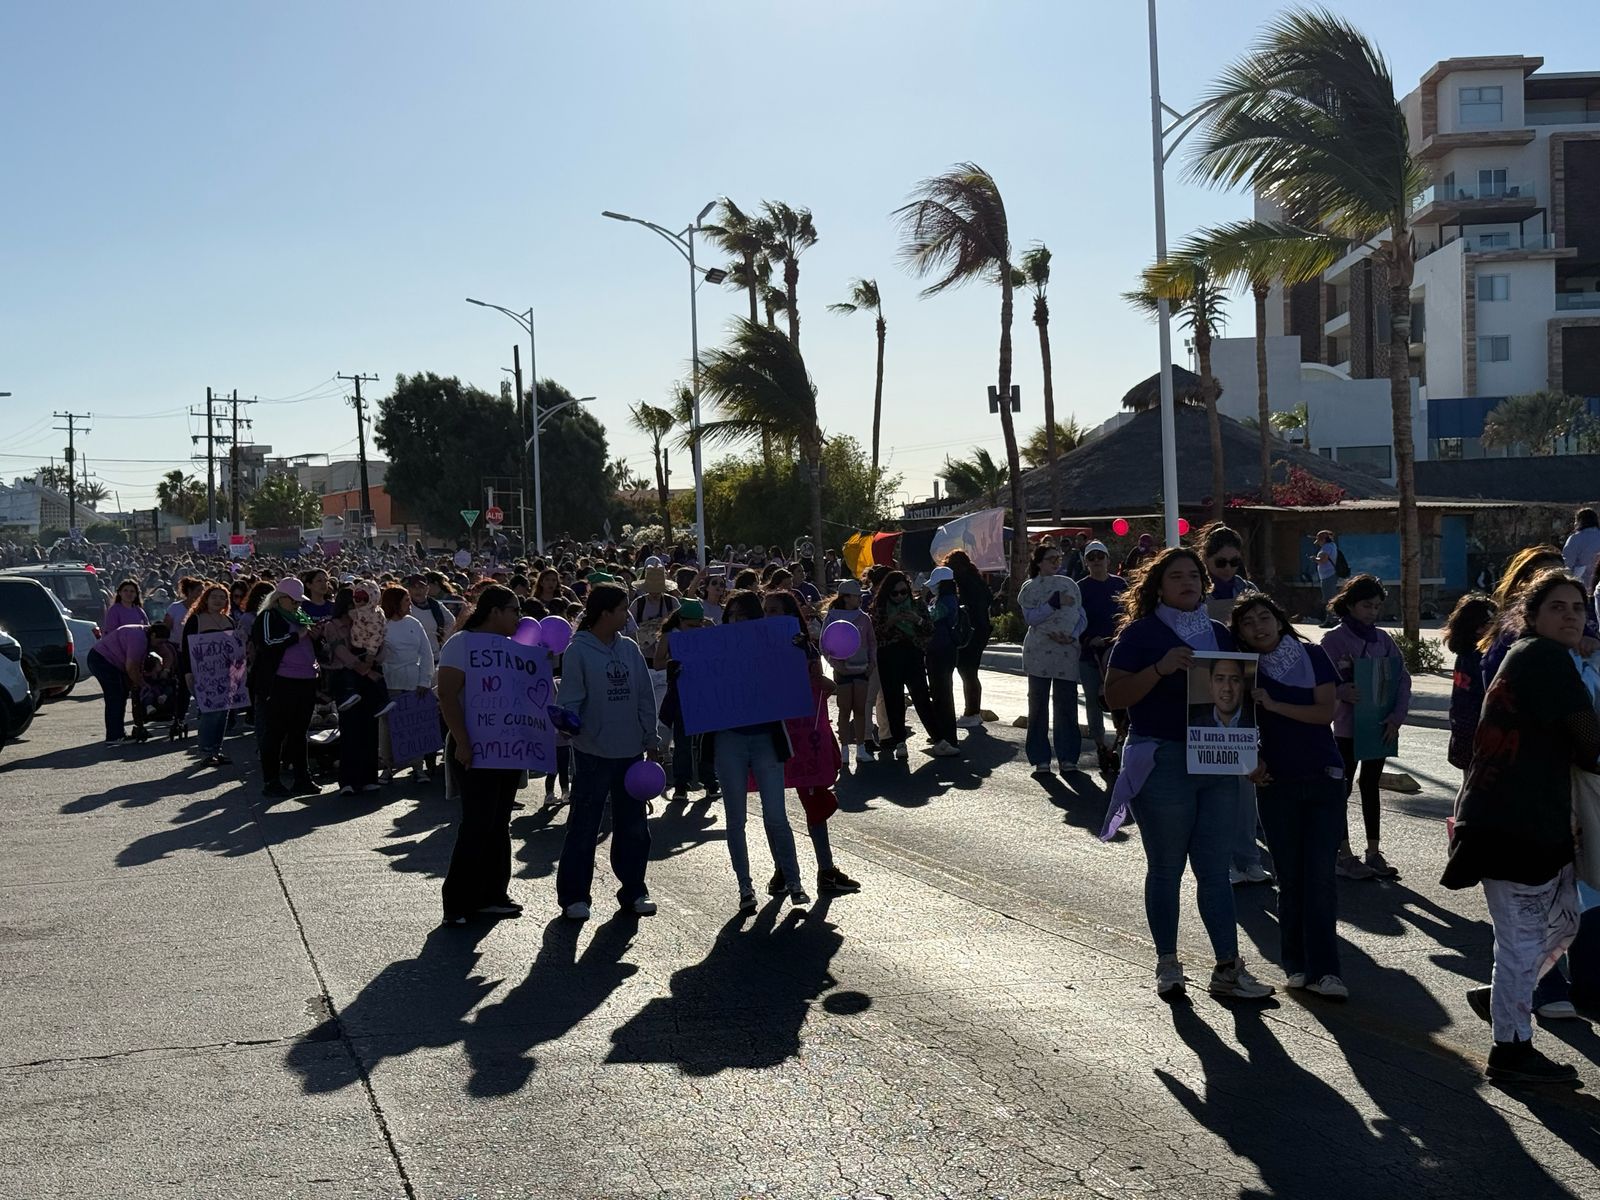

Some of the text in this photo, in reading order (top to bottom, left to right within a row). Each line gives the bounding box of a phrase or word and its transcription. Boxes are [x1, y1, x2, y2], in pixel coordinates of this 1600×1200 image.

[469, 649, 537, 676] ESTADO
[482, 675, 502, 692] NO
[470, 695, 521, 709] CUIDA
[478, 713, 547, 731] ME CUIDAN
[1204, 733, 1225, 742] una
[471, 739, 546, 762] AMIGAS
[1197, 751, 1239, 765] VIOLADOR
